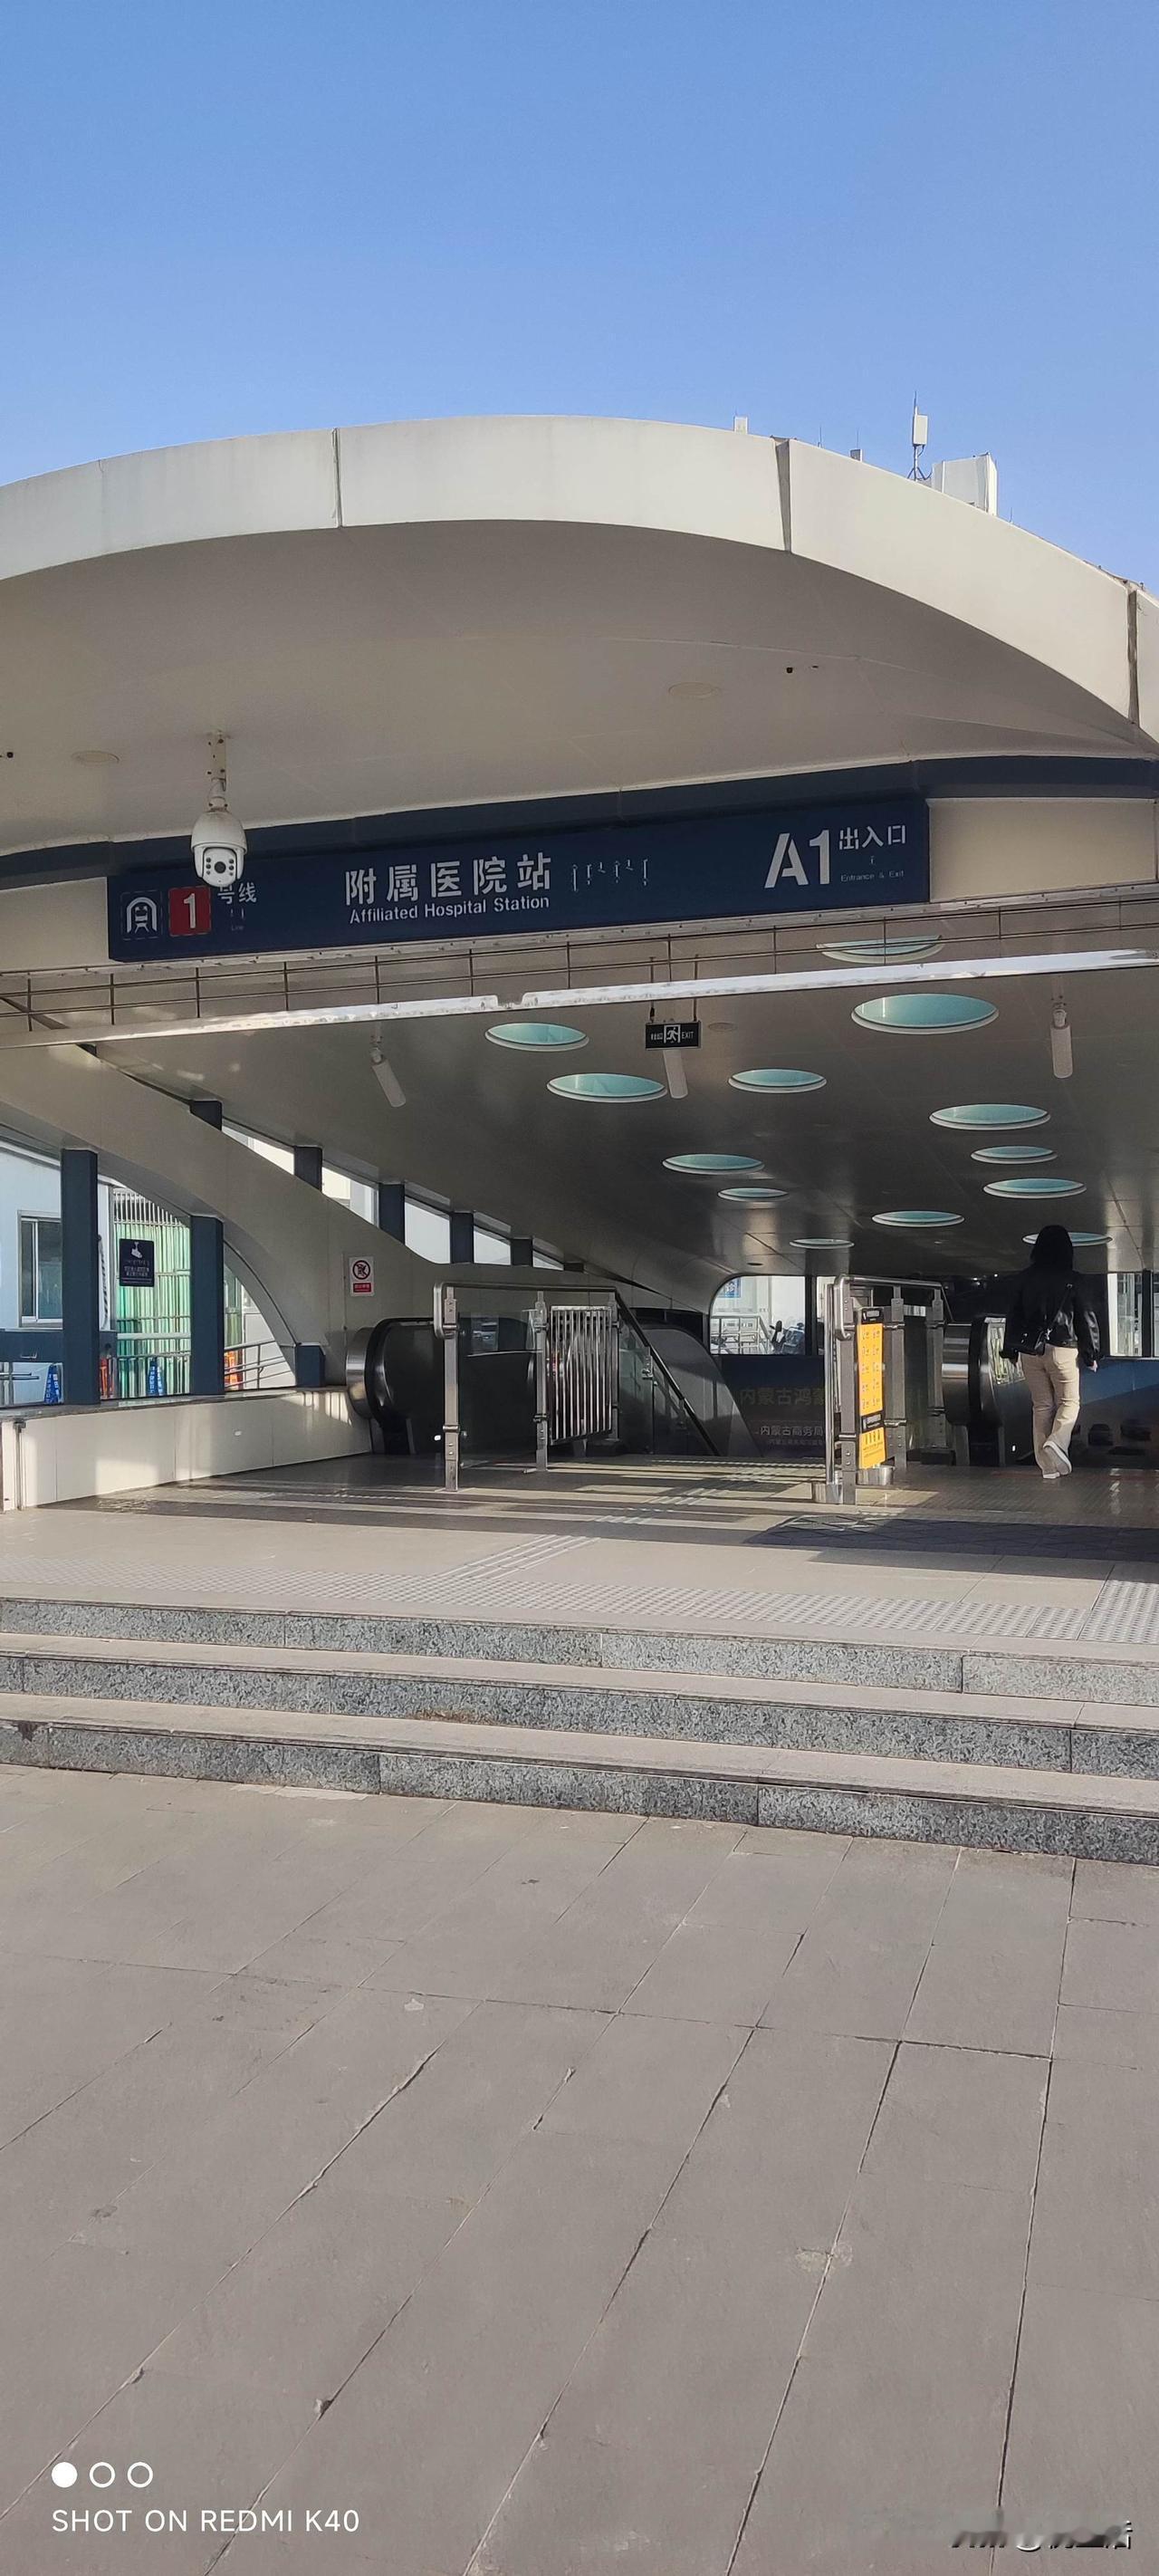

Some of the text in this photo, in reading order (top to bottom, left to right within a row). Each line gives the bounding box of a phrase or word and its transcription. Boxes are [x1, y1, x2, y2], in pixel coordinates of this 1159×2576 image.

[839, 825, 905, 850] 出入口
[764, 830, 830, 889] A1
[345, 852, 551, 906] 附属医院站
[840, 873, 875, 882] Entrance
[184, 893, 196, 928] 1
[217, 882, 257, 905] 号线
[350, 897, 550, 924] Affiliated Hospital Station
[681, 1031, 694, 1040] EXIT
